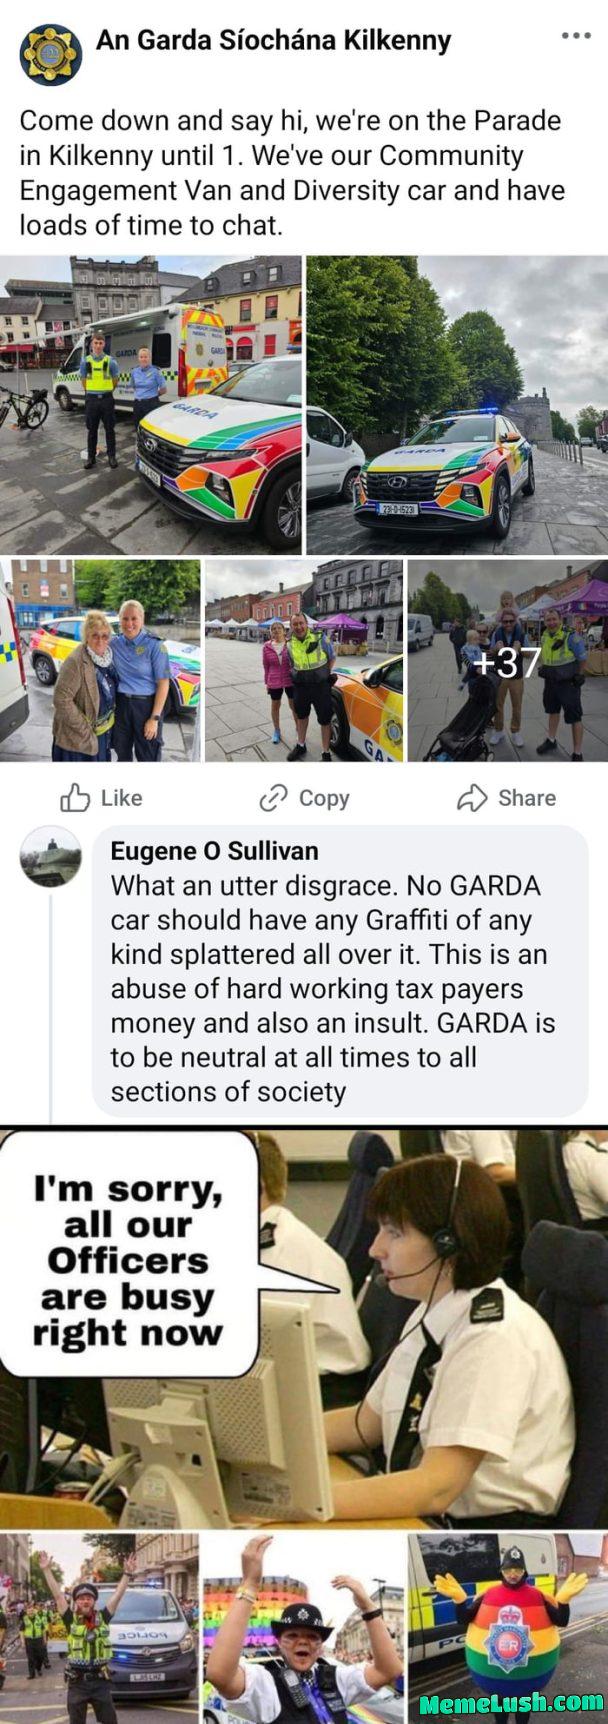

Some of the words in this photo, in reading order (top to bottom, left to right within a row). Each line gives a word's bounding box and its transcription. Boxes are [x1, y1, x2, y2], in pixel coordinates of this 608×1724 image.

[96, 29, 129, 50] An
[138, 28, 211, 50] Garda
[220, 28, 336, 50] Síochána
[345, 28, 452, 56] Kilkenny
[21, 109, 93, 131] Come
[102, 108, 168, 131] down
[178, 108, 222, 131] and
[231, 115, 273, 136] say
[282, 108, 308, 134] hi,
[316, 109, 380, 131] we're
[389, 114, 418, 131] on
[426, 108, 466, 131] the
[475, 109, 561, 131] Parade
[21, 144, 40, 165] in
[50, 144, 153, 171] Kilkenny
[162, 144, 213, 165] until
[223, 145, 242, 165] 1.
[252, 144, 323, 165] We've
[331, 149, 372, 165] our
[380, 144, 524, 171] Community
[21, 179, 177, 206] Engagement
[184, 179, 231, 200] Van
[240, 178, 284, 200] and
[295, 179, 400, 206] Diversity
[408, 184, 446, 200] car
[454, 178, 499, 200] and
[508, 178, 565, 200] have
[21, 213, 86, 235] loads
[95, 213, 121, 235] of
[127, 214, 182, 235] time
[189, 216, 214, 235] to
[223, 213, 282, 235] chat.
[172, 403, 218, 419] GARDA
[102, 788, 142, 806] Like
[300, 789, 350, 811] Copy
[499, 788, 556, 806] Share
[112, 841, 197, 865] Eugene
[204, 841, 220, 860] O
[228, 840, 318, 860] Sullivan
[111, 874, 175, 896] What
[183, 880, 211, 896] an
[221, 876, 278, 896] utter
[286, 874, 397, 901] disgrace.
[408, 875, 441, 896] No
[451, 875, 541, 896] GARDA
[111, 914, 150, 930] car
[158, 908, 240, 930] should
[250, 908, 306, 930] have
[315, 914, 358, 936] any
[367, 908, 447, 930] Graffiti
[456, 908, 482, 930] of
[489, 914, 532, 936] any
[112, 942, 161, 964] kind
[171, 942, 294, 970] splattered
[304, 942, 329, 964] all
[339, 948, 392, 964] over
[400, 943, 420, 964] it.
[429, 942, 481, 964] This
[491, 943, 509, 964] is
[519, 949, 547, 964] an
[112, 977, 186, 999] abuse
[195, 977, 220, 999] of
[228, 977, 281, 999] hard
[290, 977, 388, 1004] working
[396, 979, 433, 999] tax
[442, 983, 523, 1004] payers
[112, 1017, 195, 1039] money
[204, 1011, 248, 1033] and
[258, 1011, 308, 1033] also
[317, 1017, 345, 1033] an
[355, 1011, 428, 1033] insult.
[438, 1012, 527, 1033] GARDA
[537, 1012, 555, 1033] is
[110, 1048, 135, 1068] to
[144, 1046, 172, 1068] be
[182, 1046, 265, 1068] neutral
[275, 1048, 297, 1068] at
[306, 1046, 332, 1068] all
[340, 1046, 409, 1068] times
[417, 1048, 441, 1067] to
[450, 1045, 476, 1067] all
[111, 1081, 216, 1102] sections
[225, 1080, 250, 1102] of
[258, 1081, 346, 1108] society
